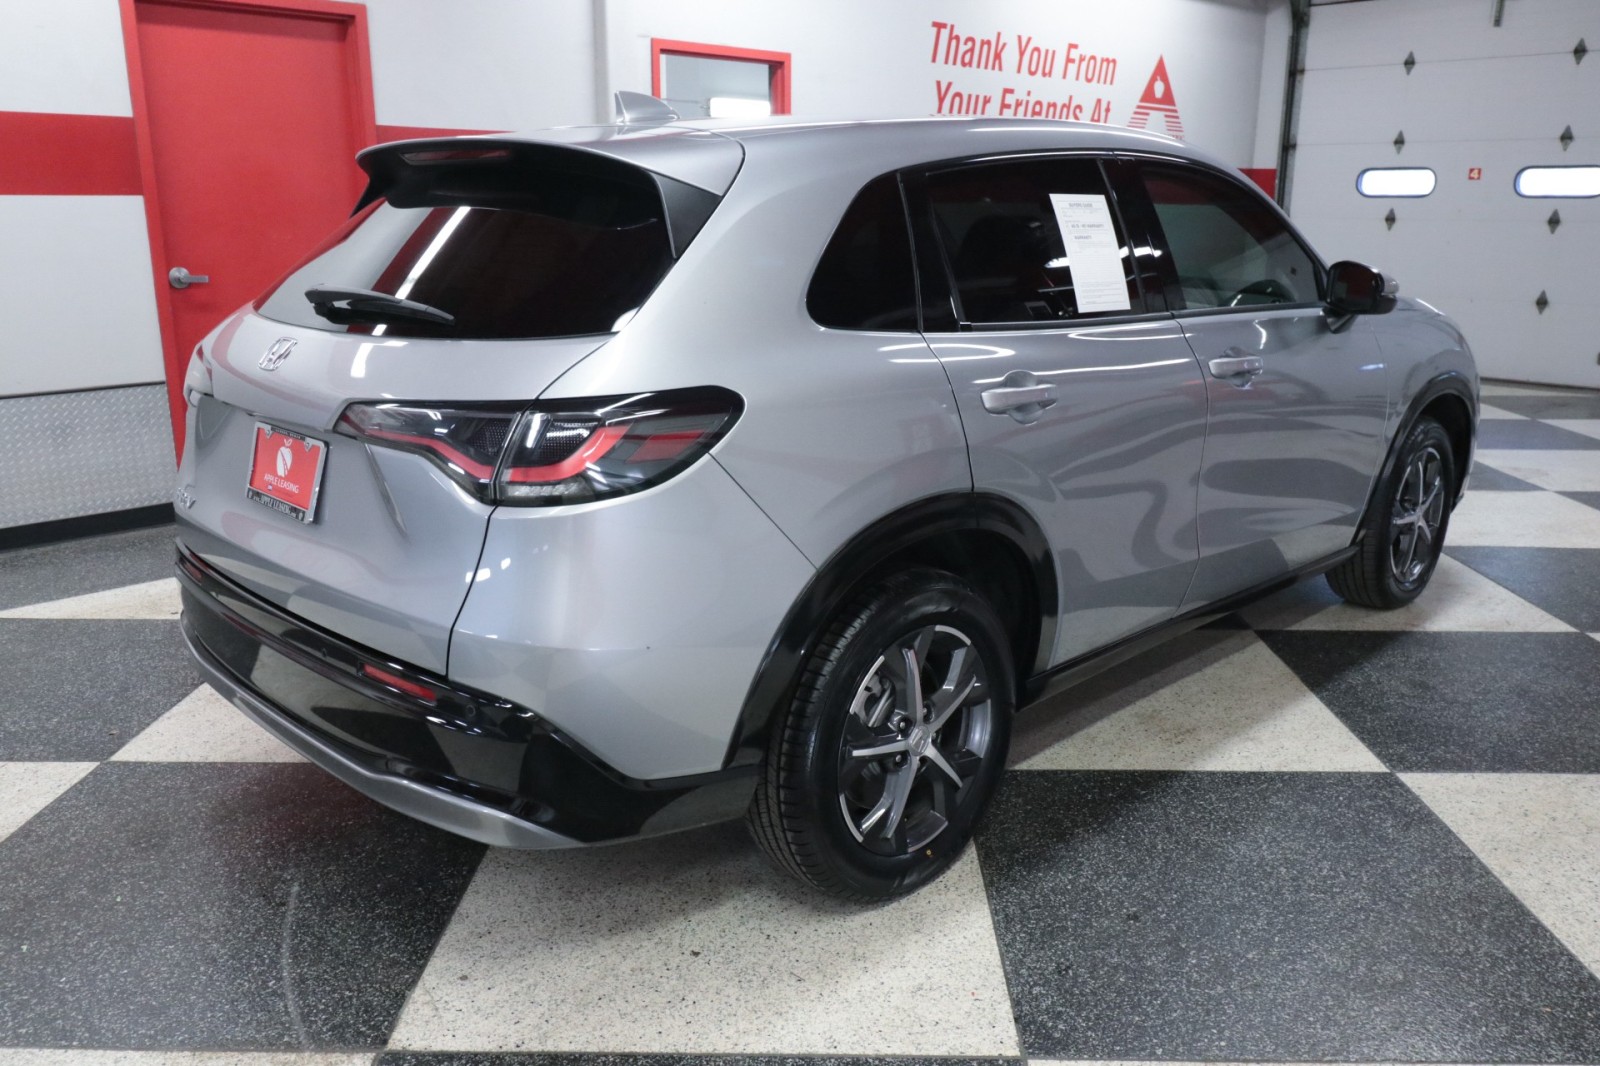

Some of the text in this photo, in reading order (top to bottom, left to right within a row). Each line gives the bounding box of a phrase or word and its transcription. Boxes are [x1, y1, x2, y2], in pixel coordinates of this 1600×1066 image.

[931, 21, 1117, 85] Thank You From
[935, 80, 1111, 124] Your Friends At
[1470, 169, 1479, 179] 4
[264, 473, 278, 486] APPLE
[277, 478, 300, 494] LEASING
